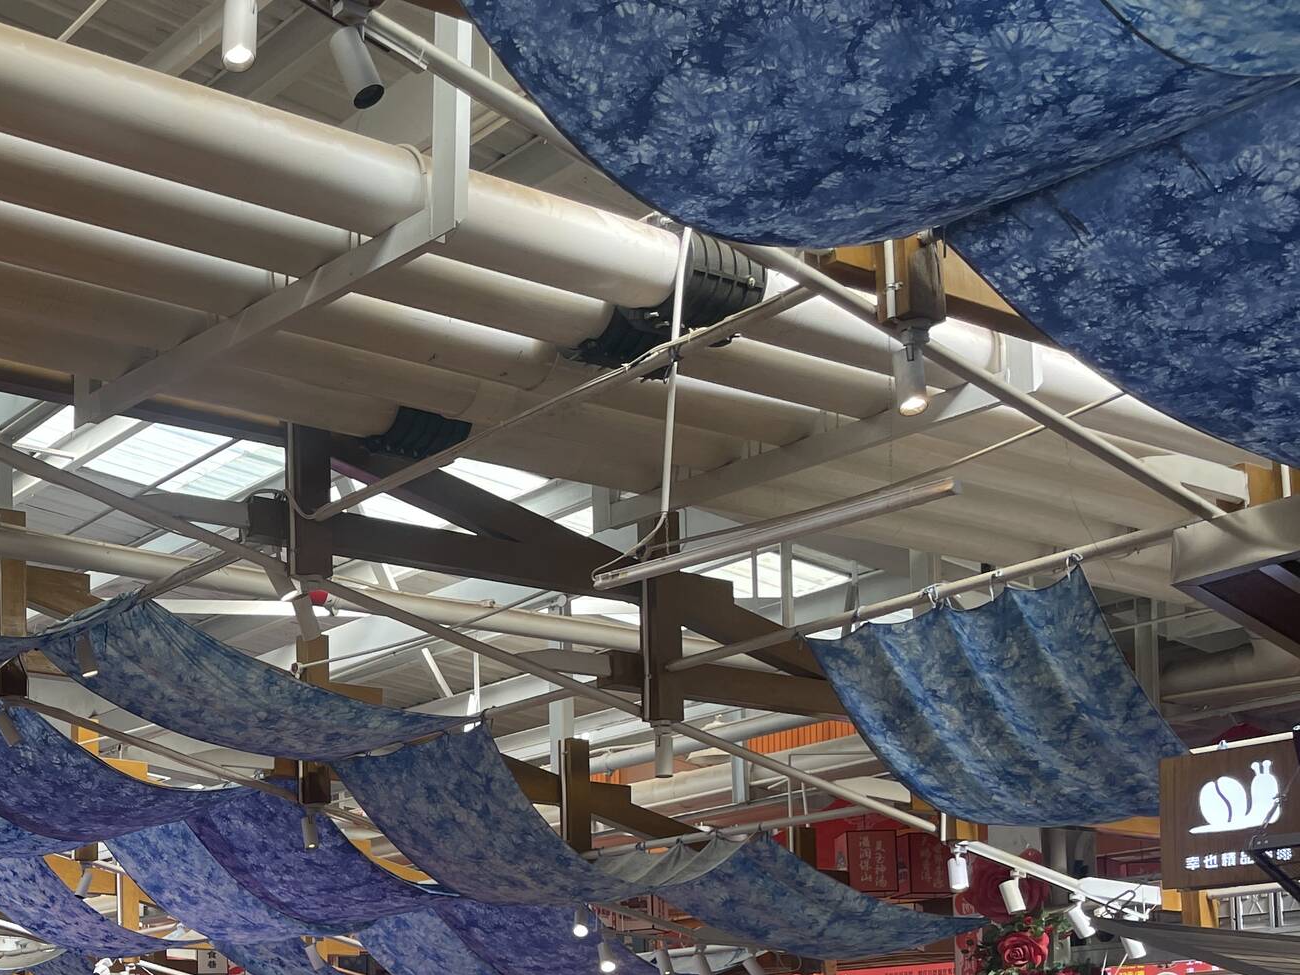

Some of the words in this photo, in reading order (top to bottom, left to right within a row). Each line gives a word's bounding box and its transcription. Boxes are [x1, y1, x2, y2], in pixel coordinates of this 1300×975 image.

[1185, 847, 1292, 870] 幸也精品啡
